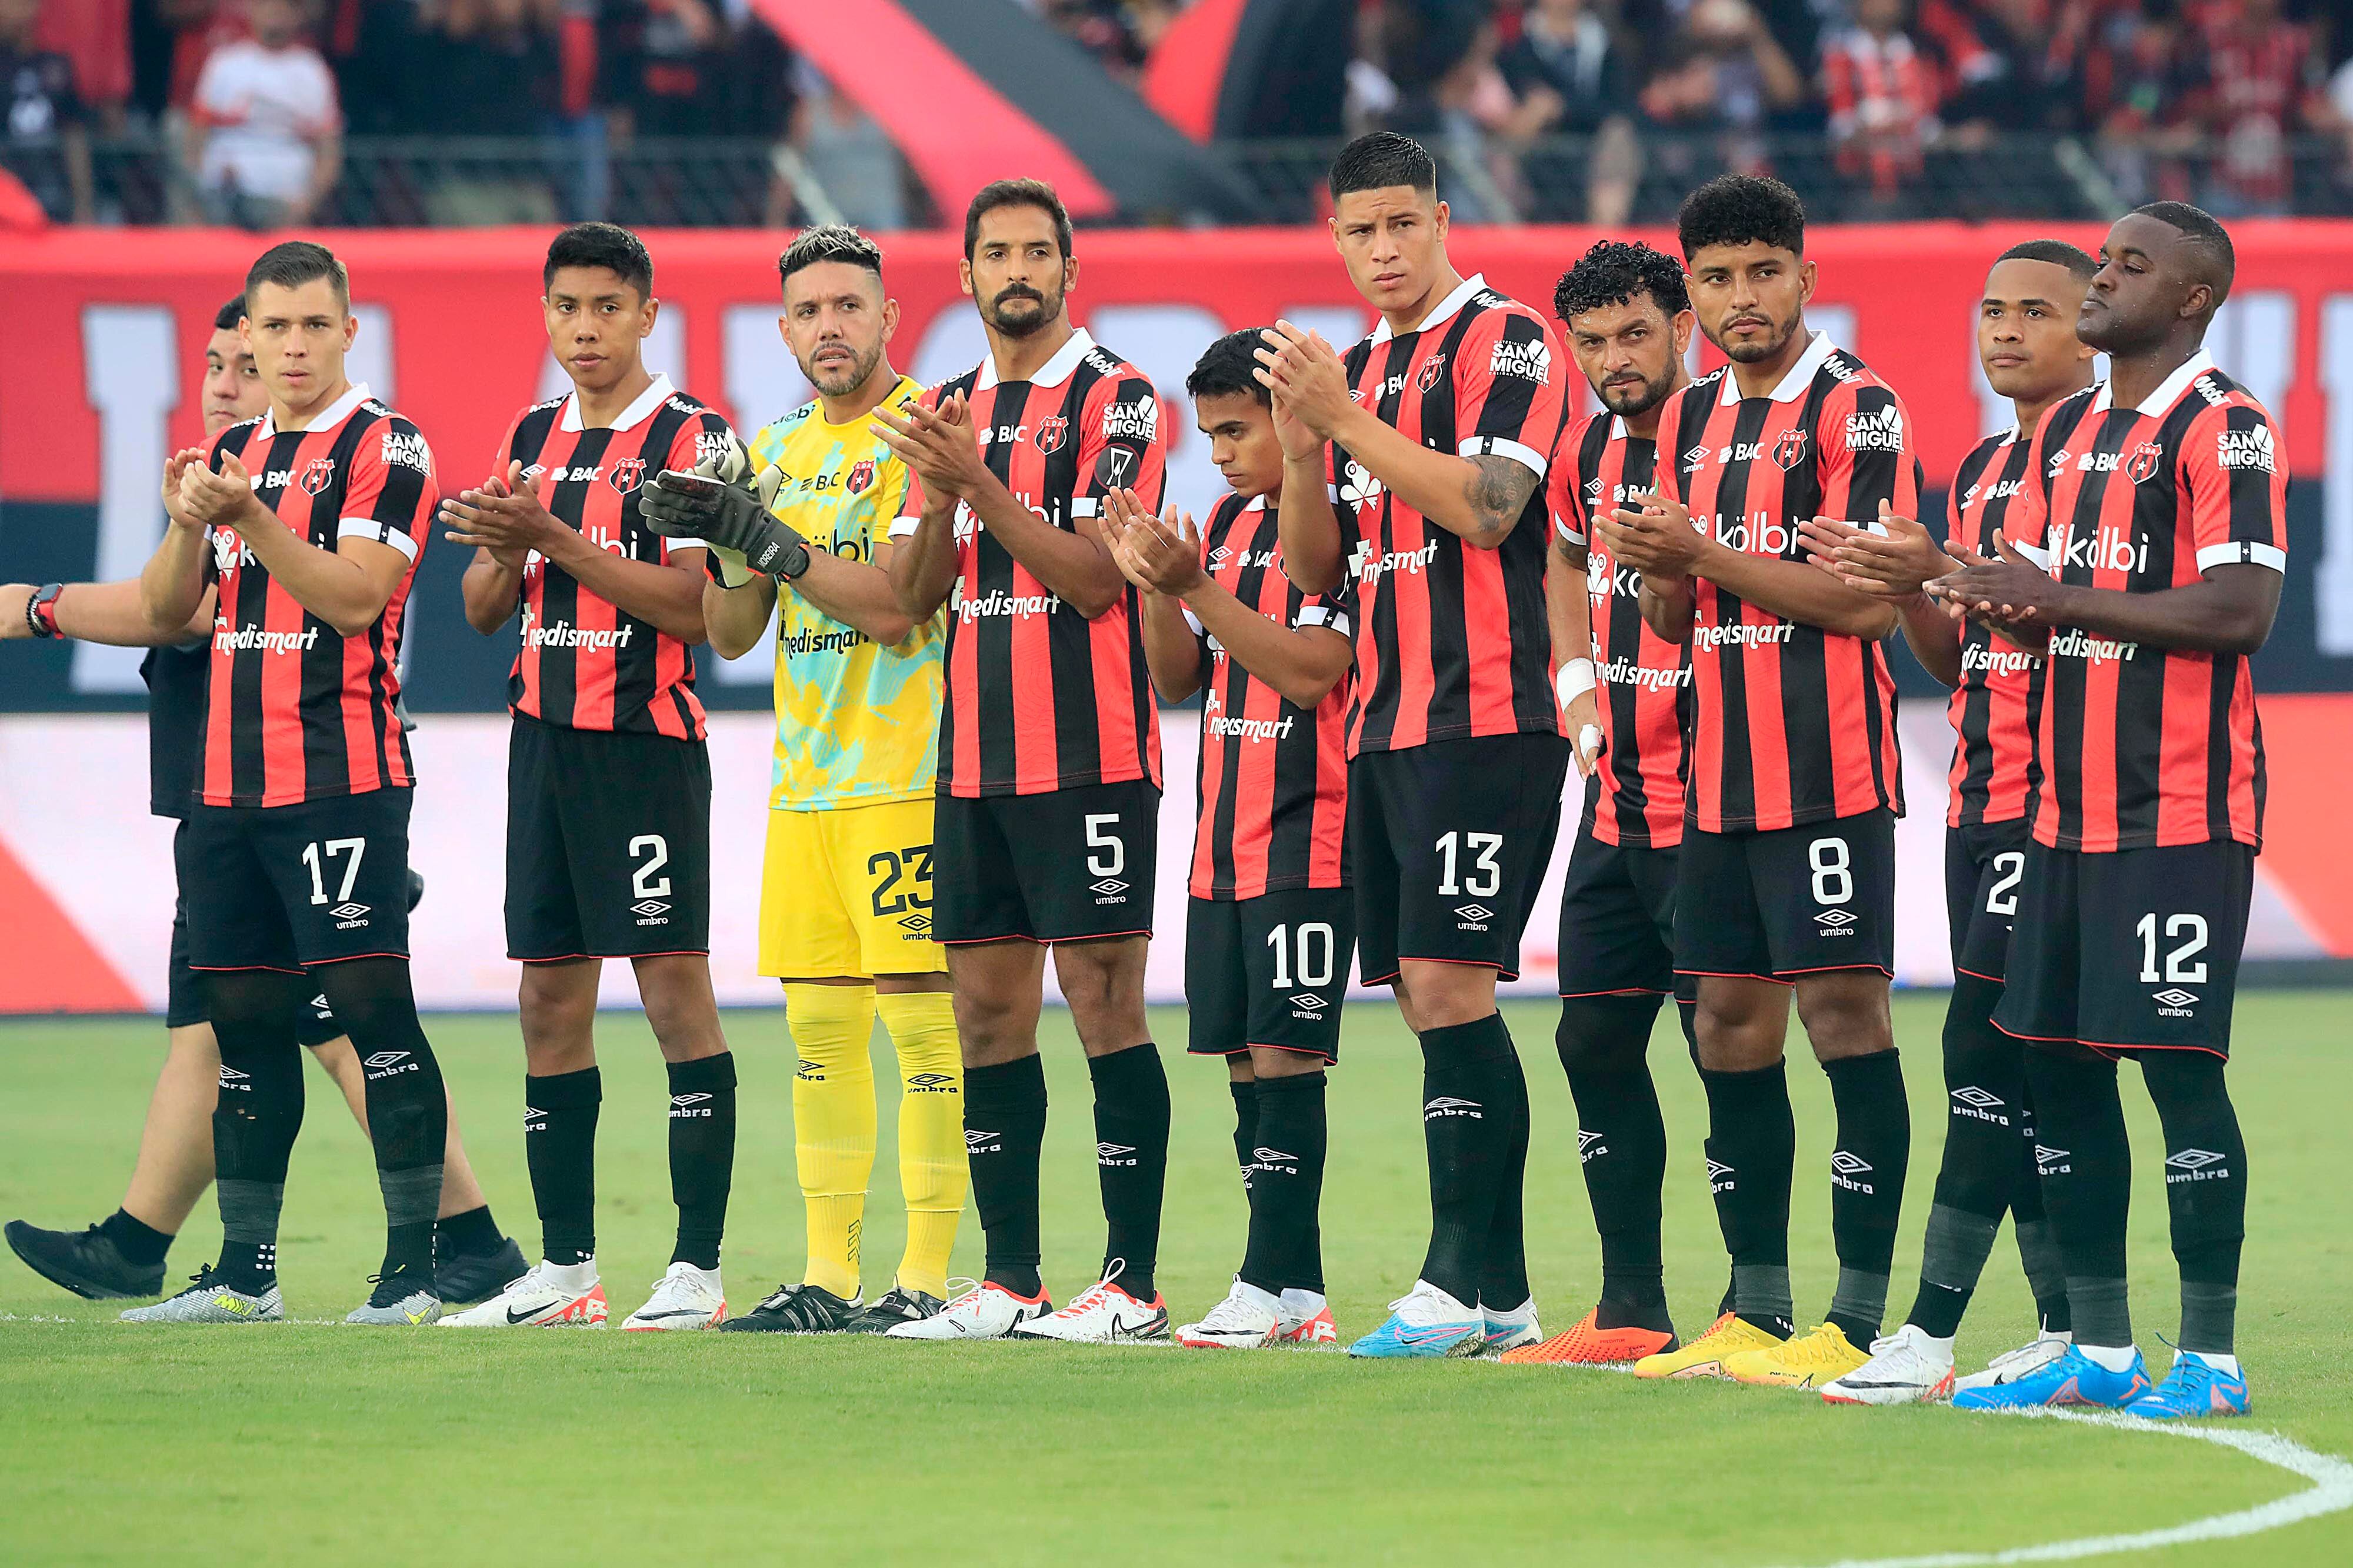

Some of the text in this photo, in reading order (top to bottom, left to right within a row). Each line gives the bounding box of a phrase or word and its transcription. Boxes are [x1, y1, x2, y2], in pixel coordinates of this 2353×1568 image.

[1492, 343, 1528, 362] SAN
[1489, 356, 1550, 385] MIGUEL
[1824, 353, 1865, 385] Mobil
[1103, 405, 1139, 421] SAN
[1102, 419, 1158, 441] MIGUEL
[1845, 415, 1883, 432] SAN
[382, 435, 415, 453] SAN
[695, 435, 728, 451] SAN
[1845, 431, 1905, 452] MIGUEL
[2217, 434, 2255, 451] SAN
[1734, 442, 1765, 461] BAC
[2217, 449, 2278, 473] MIGUEL
[382, 448, 432, 478] MIGUEL
[1683, 462, 1704, 473] umbro
[2094, 452, 2125, 472] BAC
[265, 470, 296, 489] BAC
[569, 466, 604, 482] BAC
[816, 472, 841, 491] BC
[1996, 480, 2026, 498] BAC
[1715, 511, 1799, 555] kölbi
[757, 541, 781, 568] MOREIRA
[2062, 523, 2149, 573] kölbi
[1208, 561, 1226, 571] umbro
[2048, 628, 2138, 665] edismart
[1085, 813, 1124, 876] 5
[302, 837, 366, 905] 17
[629, 834, 671, 899] 2
[1435, 831, 1503, 897] 13
[1809, 837, 1853, 905] 8
[868, 844, 934, 917] 23
[1095, 895, 1126, 905] umbro
[336, 919, 369, 929] umbro
[636, 916, 668, 926] umbro
[1458, 922, 1488, 932] umbro
[1820, 927, 1854, 937] umbro
[1268, 922, 1334, 989] 10
[2137, 912, 2208, 983] 12
[1292, 1010, 1322, 1020] umbro
[2158, 1006, 2194, 1017] umbro
